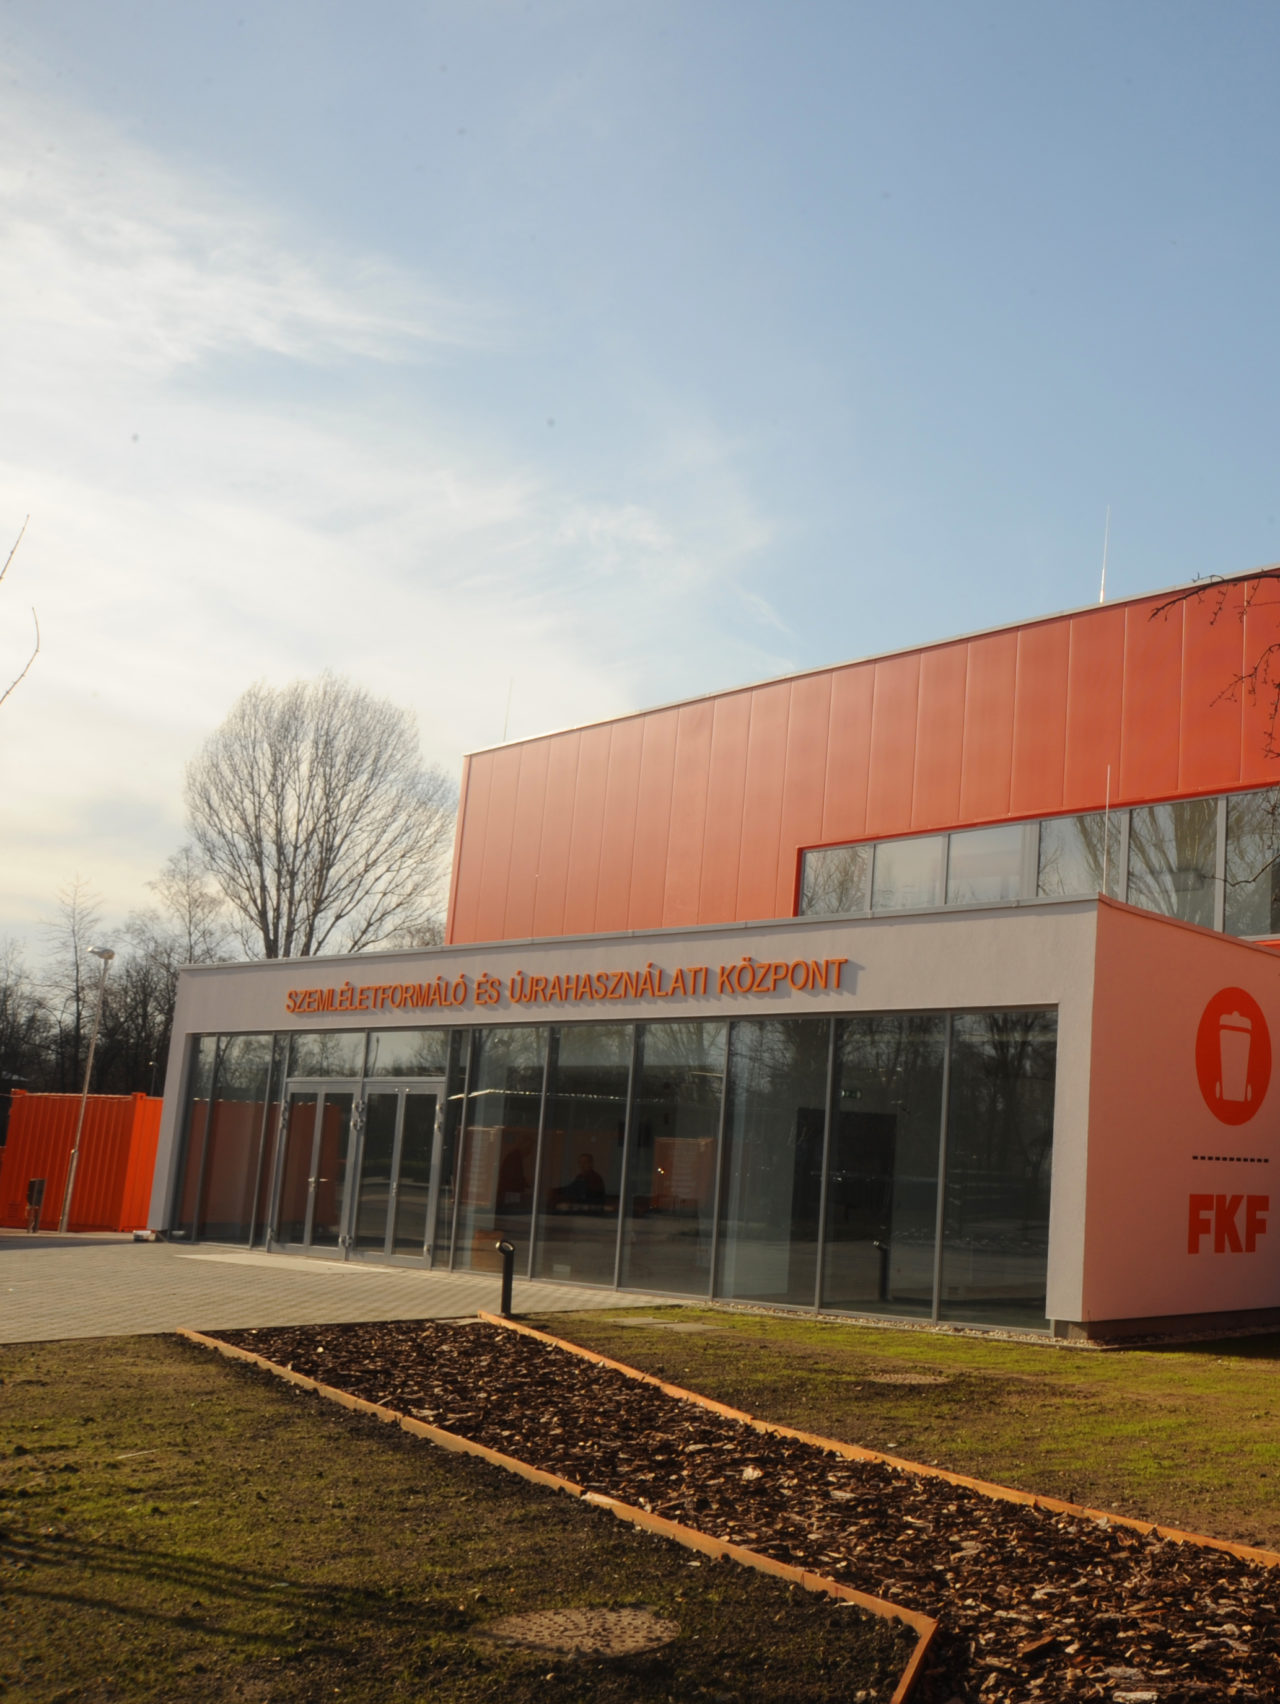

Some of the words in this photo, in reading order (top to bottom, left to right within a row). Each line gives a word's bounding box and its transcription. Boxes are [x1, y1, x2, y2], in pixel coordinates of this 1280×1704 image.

[286, 973, 467, 1013] SZEMLÉLETFORMÁLÓ
[475, 972, 501, 1005] ÉS
[509, 962, 708, 1004] ÚJRAHASZNÁLATI
[717, 957, 849, 995] KÖZPONT
[1187, 1193, 1270, 1255] FKF
